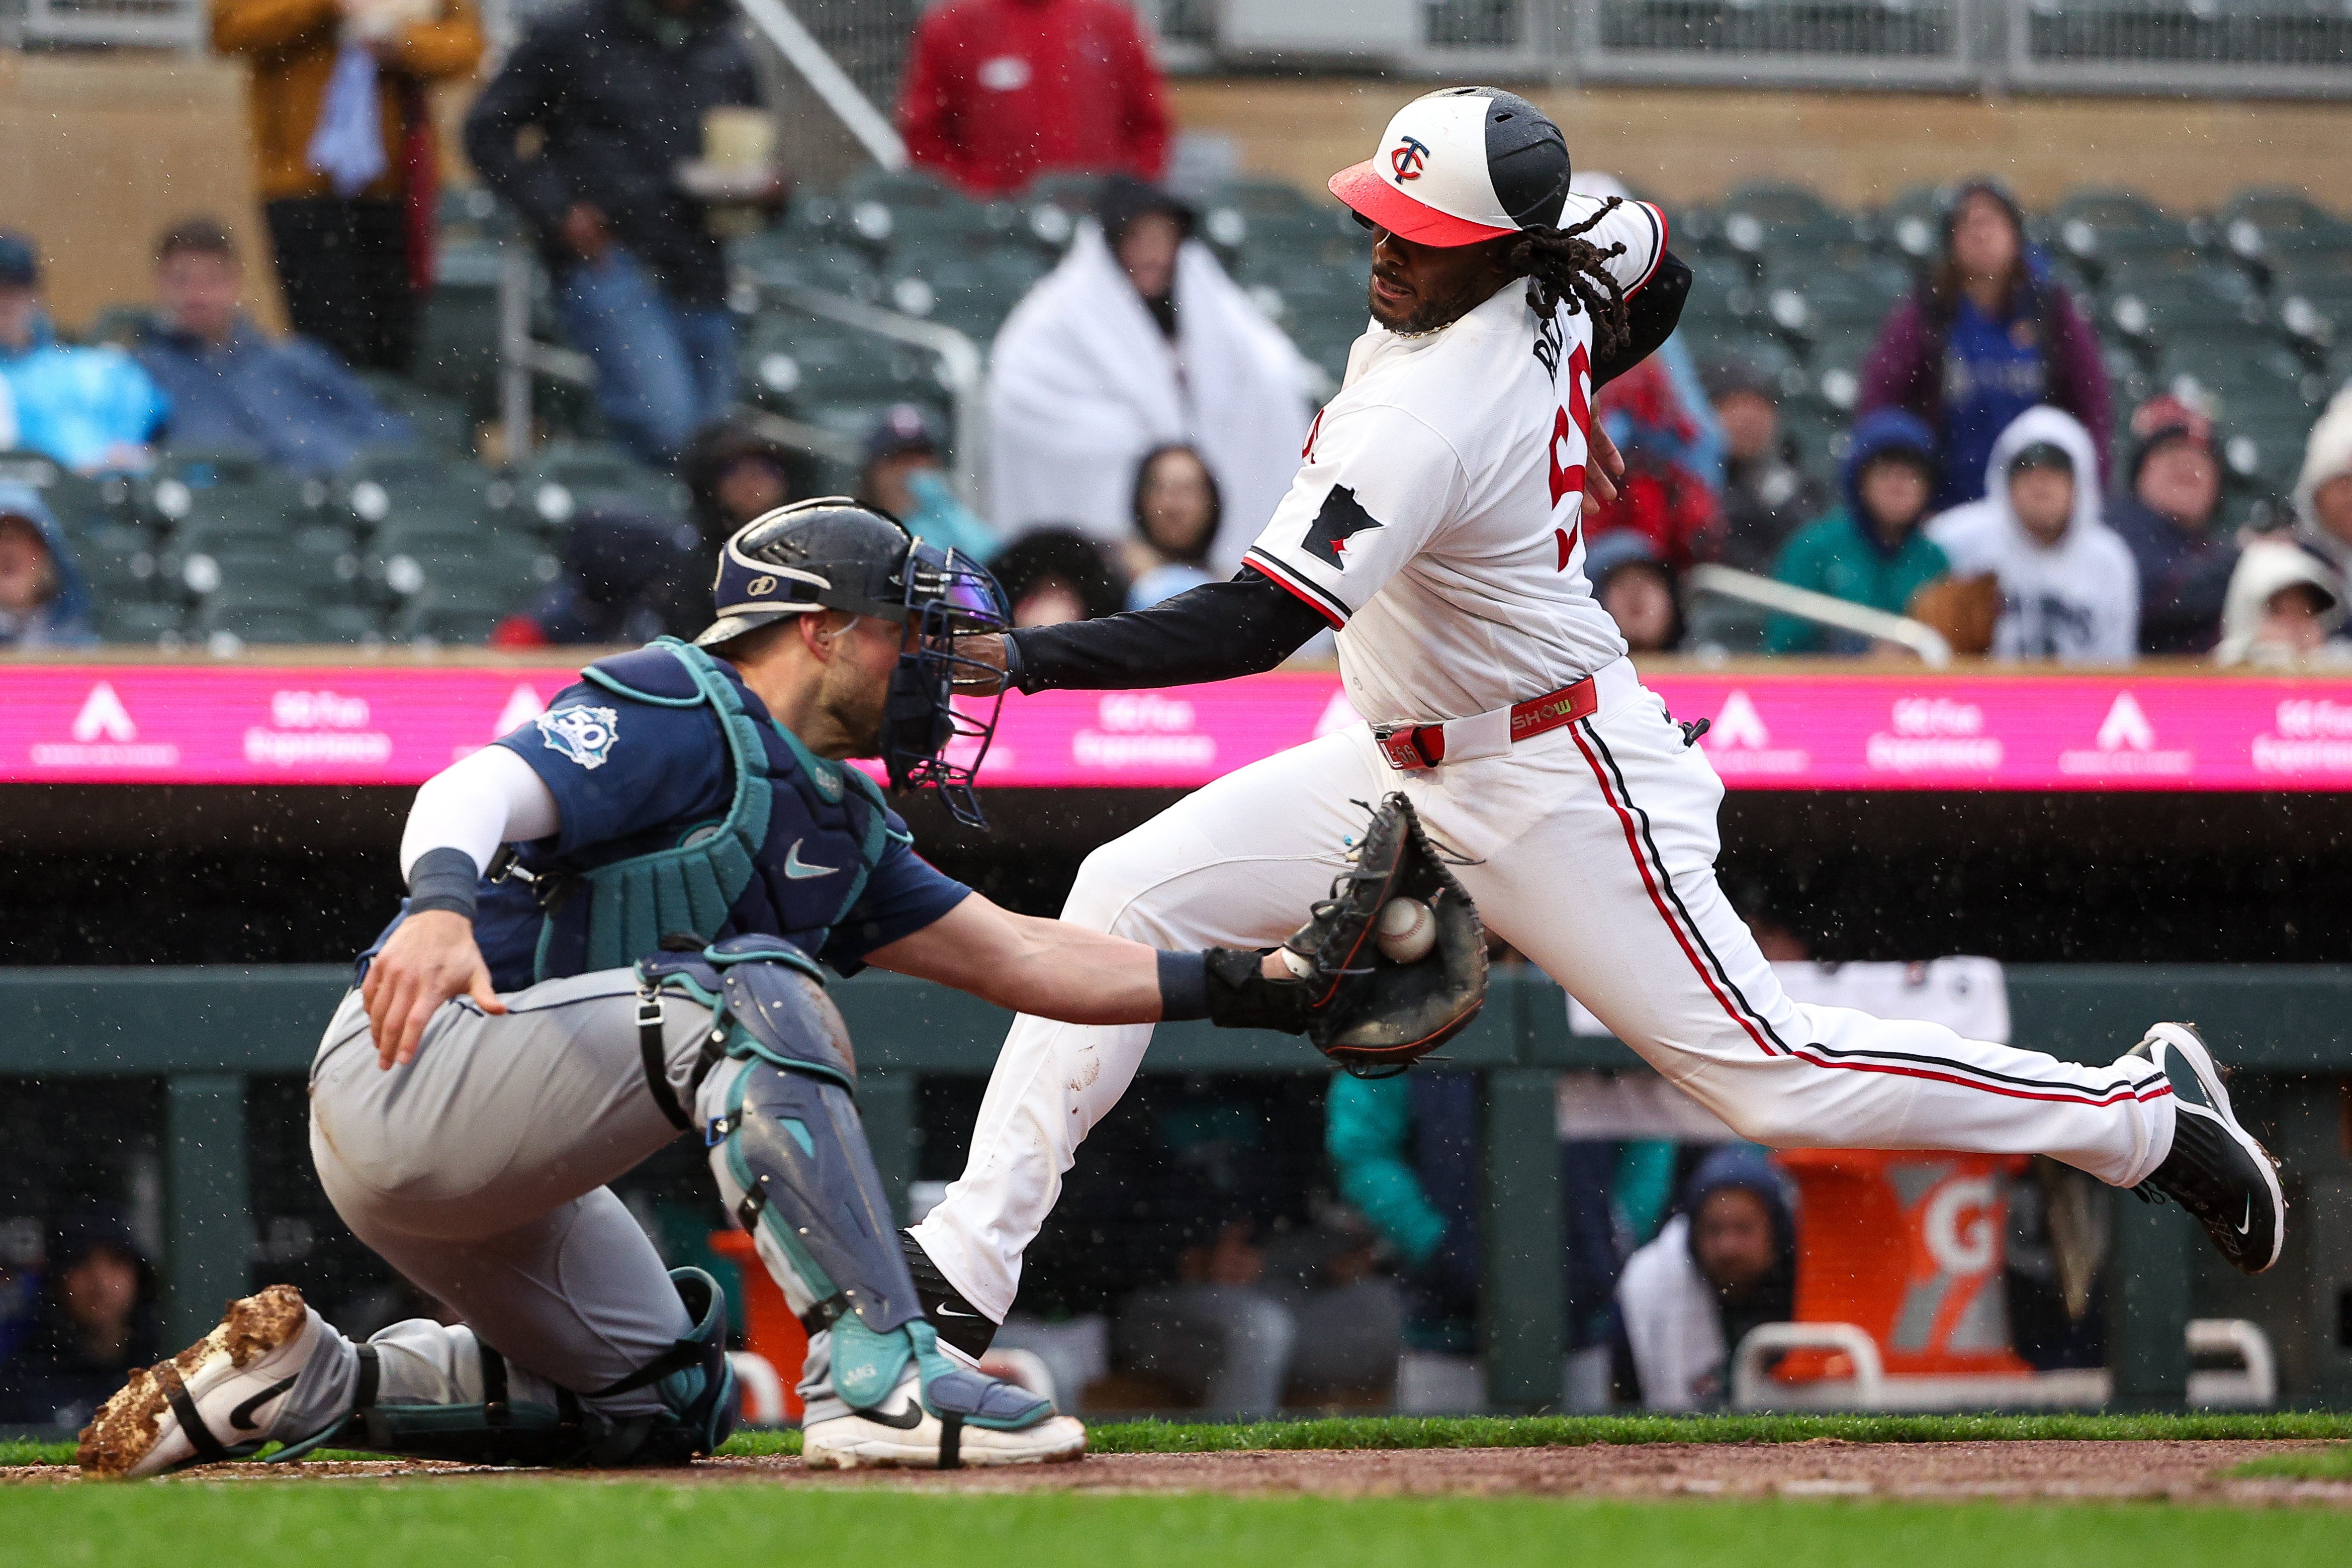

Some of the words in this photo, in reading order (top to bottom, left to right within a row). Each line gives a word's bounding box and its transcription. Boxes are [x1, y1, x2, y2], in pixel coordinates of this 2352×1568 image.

[558, 711, 608, 749] 50
[1511, 699, 1571, 729] SHOW
[1397, 744, 1418, 764] 56
[1924, 1176, 1995, 1273] G
